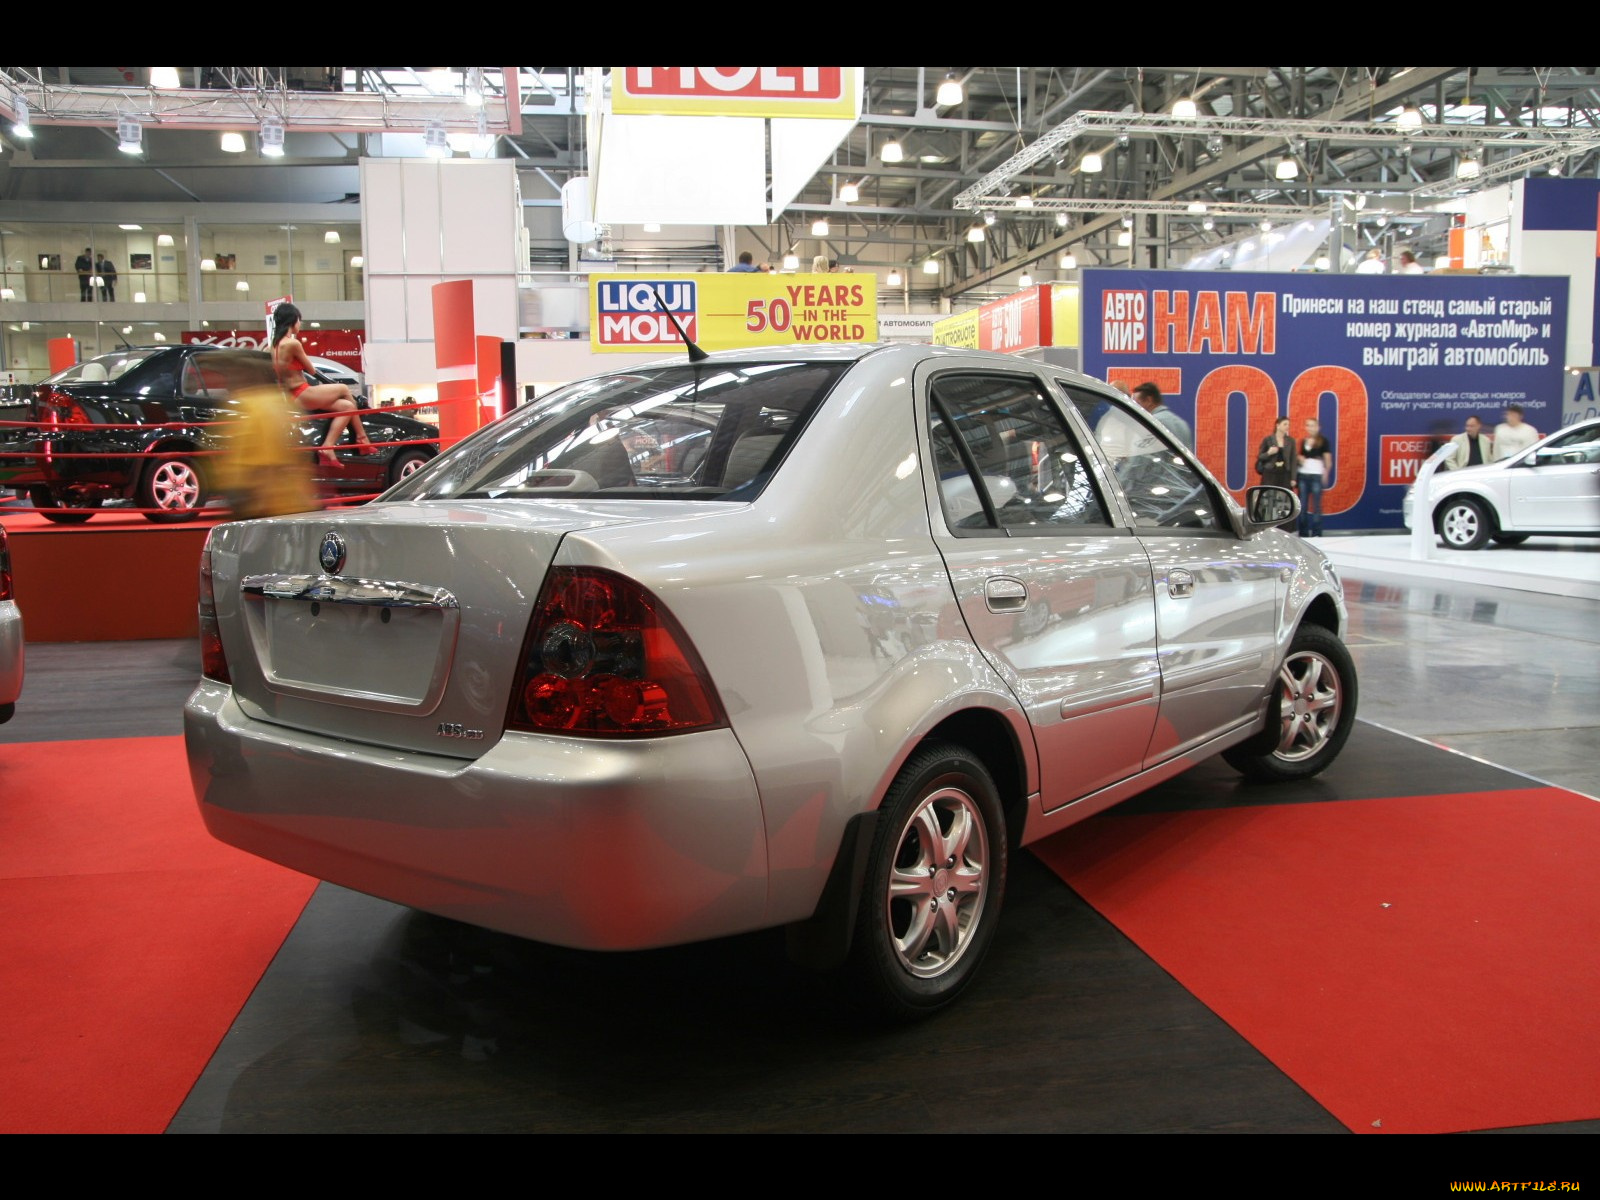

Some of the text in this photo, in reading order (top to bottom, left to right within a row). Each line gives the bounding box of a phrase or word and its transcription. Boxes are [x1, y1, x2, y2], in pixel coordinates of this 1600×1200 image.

[602, 283, 691, 312] LIQUI
[786, 285, 864, 306] YEARS
[1104, 292, 1145, 321] АВТО
[1282, 293, 1551, 319] Принеси на наш стенд самый старый
[602, 314, 695, 341] MOLY
[746, 298, 792, 332] 50
[803, 309, 848, 322] IN THE
[1152, 290, 1276, 354] НАМ
[792, 324, 865, 341] WORLD
[1104, 321, 1145, 351] МИР
[1346, 320, 1551, 342] номер журнала «АвтоМир» и
[1362, 343, 1549, 371] выиграй автомобиль
[1381, 390, 1526, 401] Обладатели самых старых номеров
[1573, 372, 1600, 402] A
[1381, 402, 1411, 410] примут
[1412, 402, 1445, 411] участие
[1453, 401, 1501, 410] розыгрыше
[1502, 400, 1508, 408] 4
